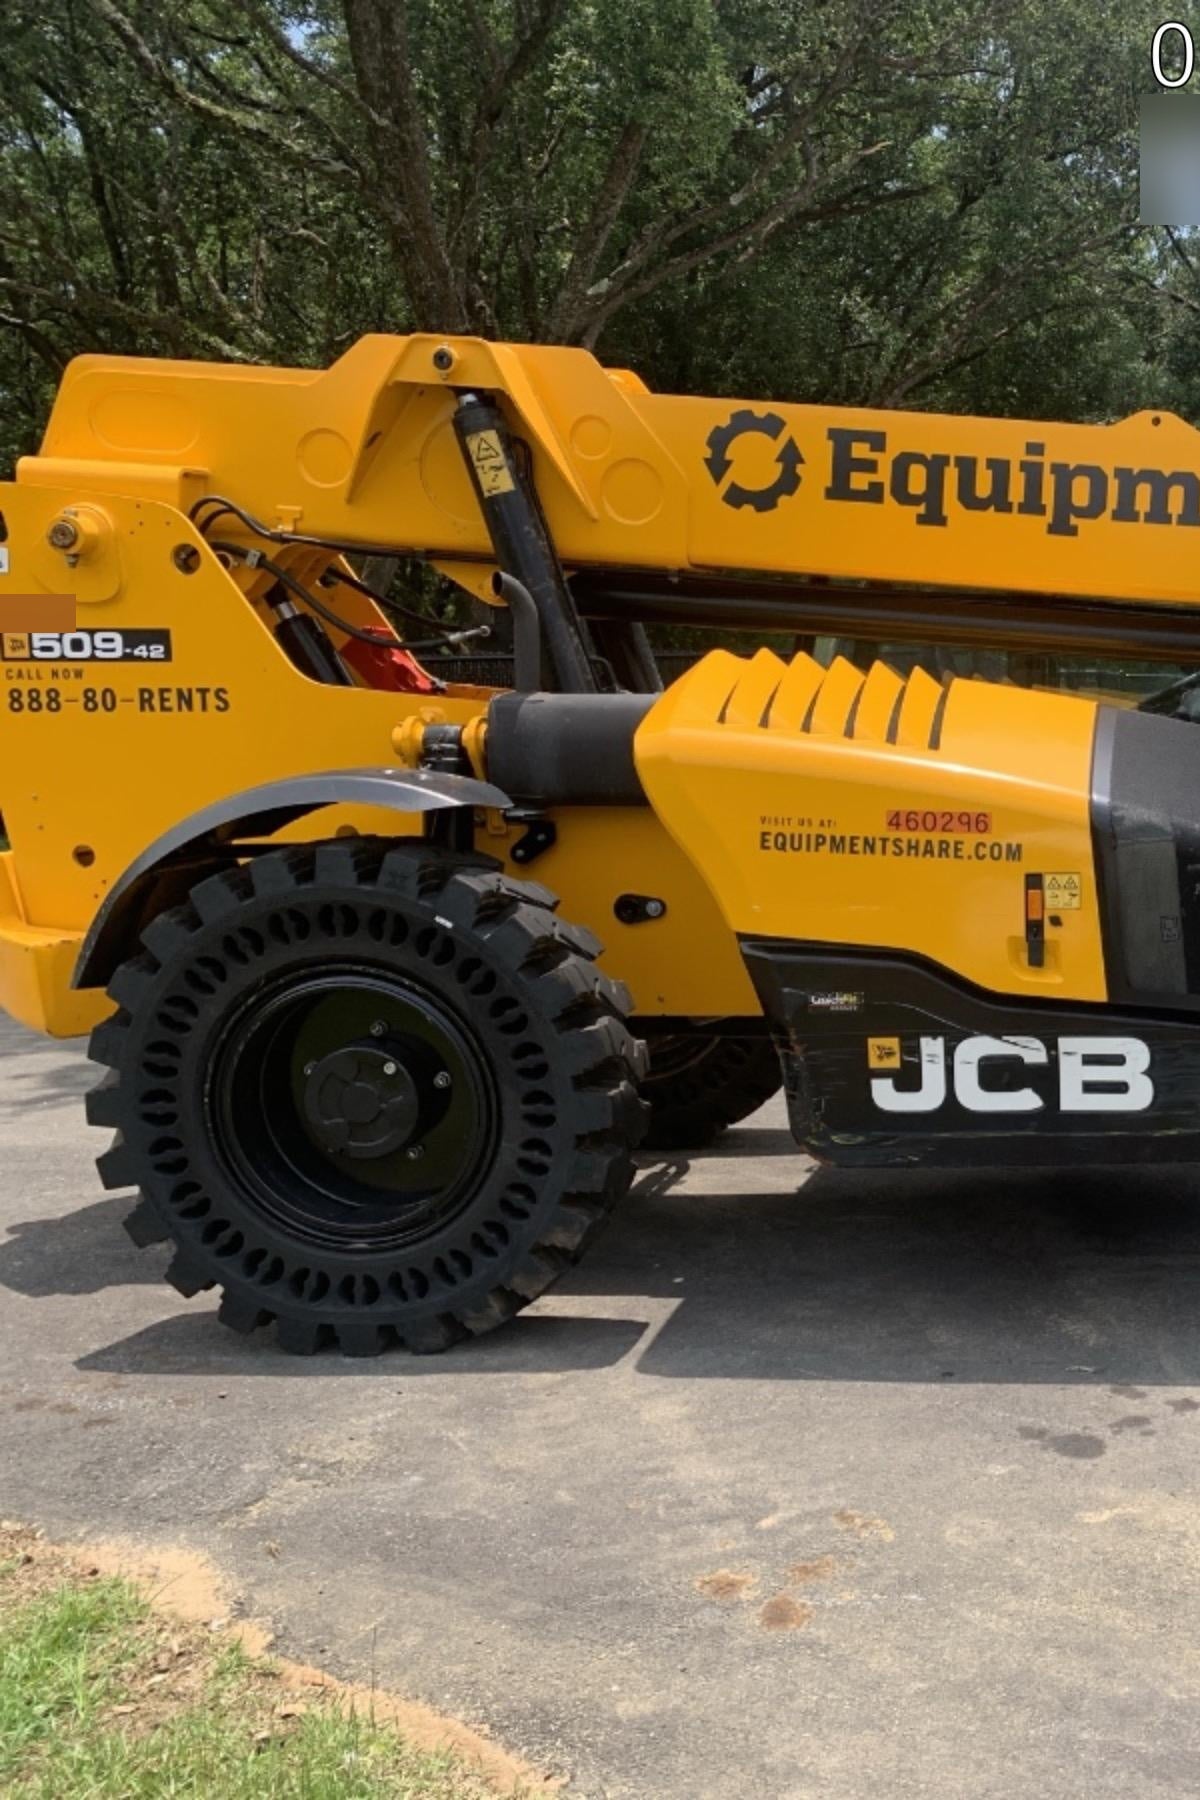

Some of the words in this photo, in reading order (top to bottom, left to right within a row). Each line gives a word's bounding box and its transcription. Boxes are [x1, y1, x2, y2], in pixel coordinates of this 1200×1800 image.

[5, 668, 43, 680] CALL
[51, 668, 84, 680] NOW
[8, 687, 231, 713] 888-80-RENTS
[760, 815, 793, 827] VISIT
[797, 817, 814, 827] US
[887, 810, 990, 833] 460296
[759, 831, 1023, 862] EQUIPMENTSHARE.COM
[870, 1036, 1155, 1112] JCB
